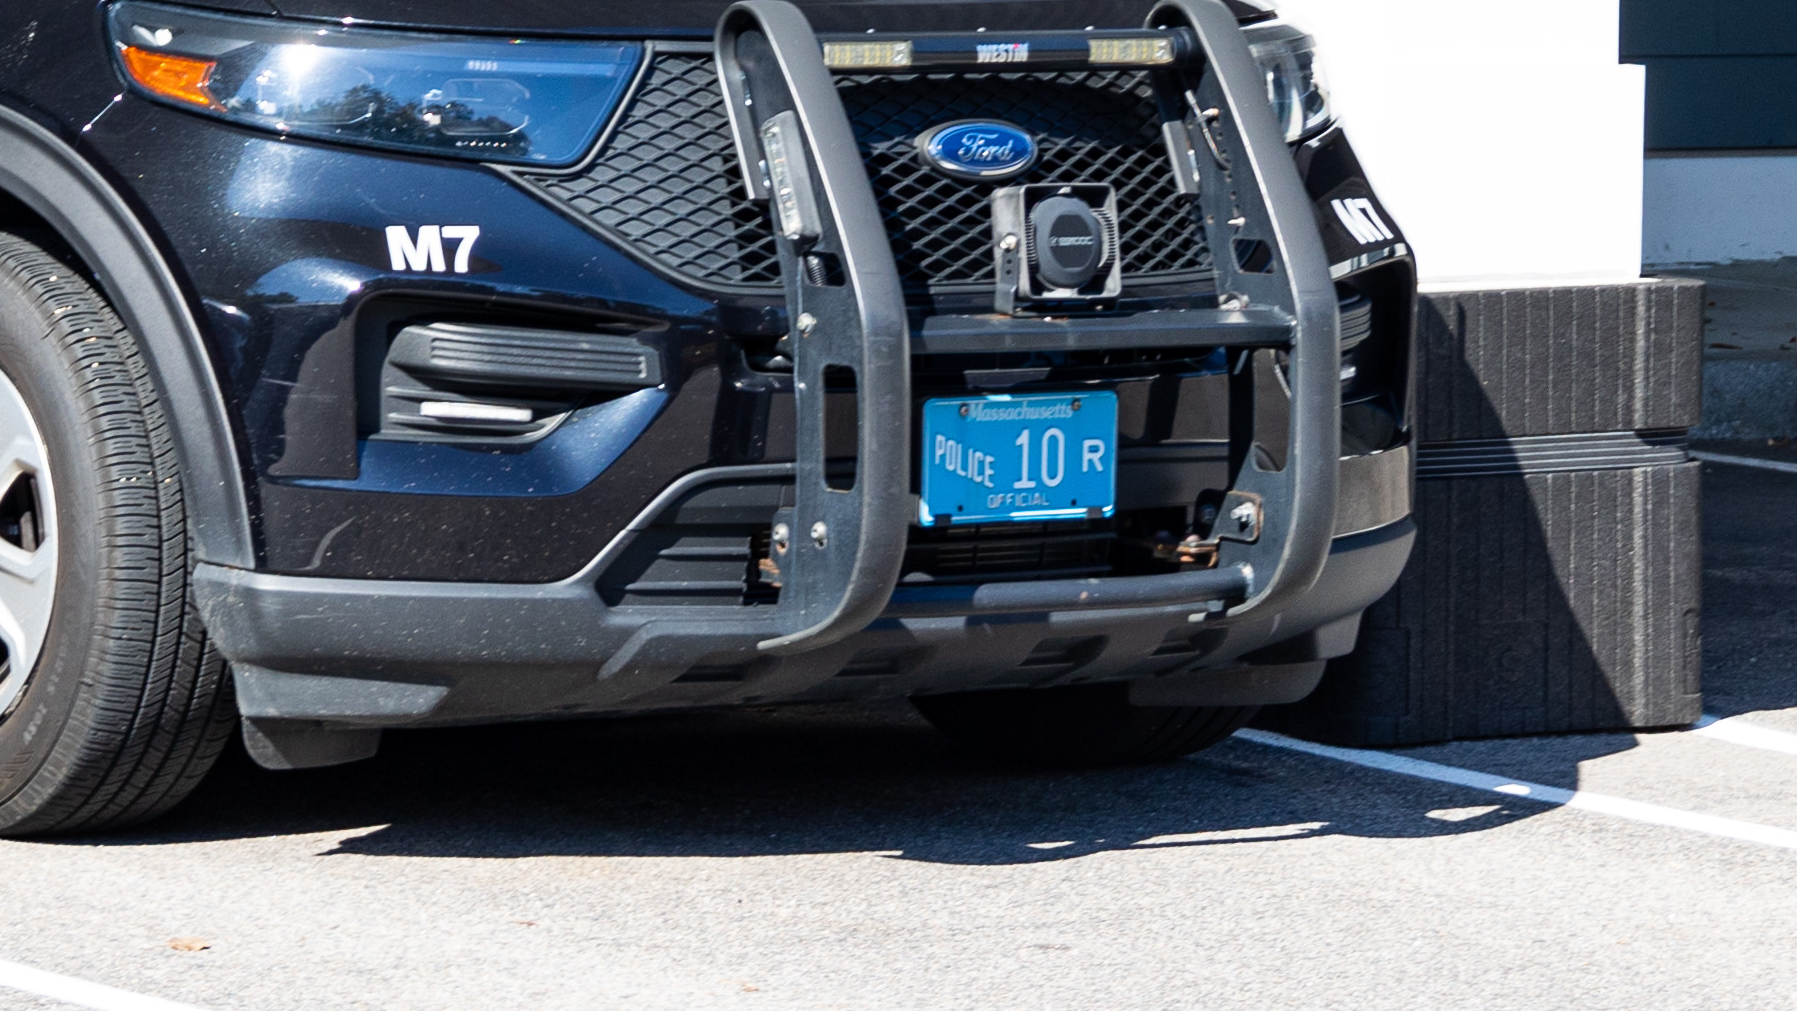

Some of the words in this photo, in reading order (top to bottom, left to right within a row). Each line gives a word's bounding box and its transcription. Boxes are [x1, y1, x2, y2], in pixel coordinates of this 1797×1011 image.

[958, 132, 1014, 162] Ford
[1330, 197, 1394, 245] M7
[385, 225, 480, 273] M7
[968, 401, 1074, 421] Massachusetts
[935, 434, 995, 489] POLICE
[1013, 427, 1065, 489] 10
[1081, 439, 1105, 473] R
[987, 493, 1050, 509] OFFICIAL
